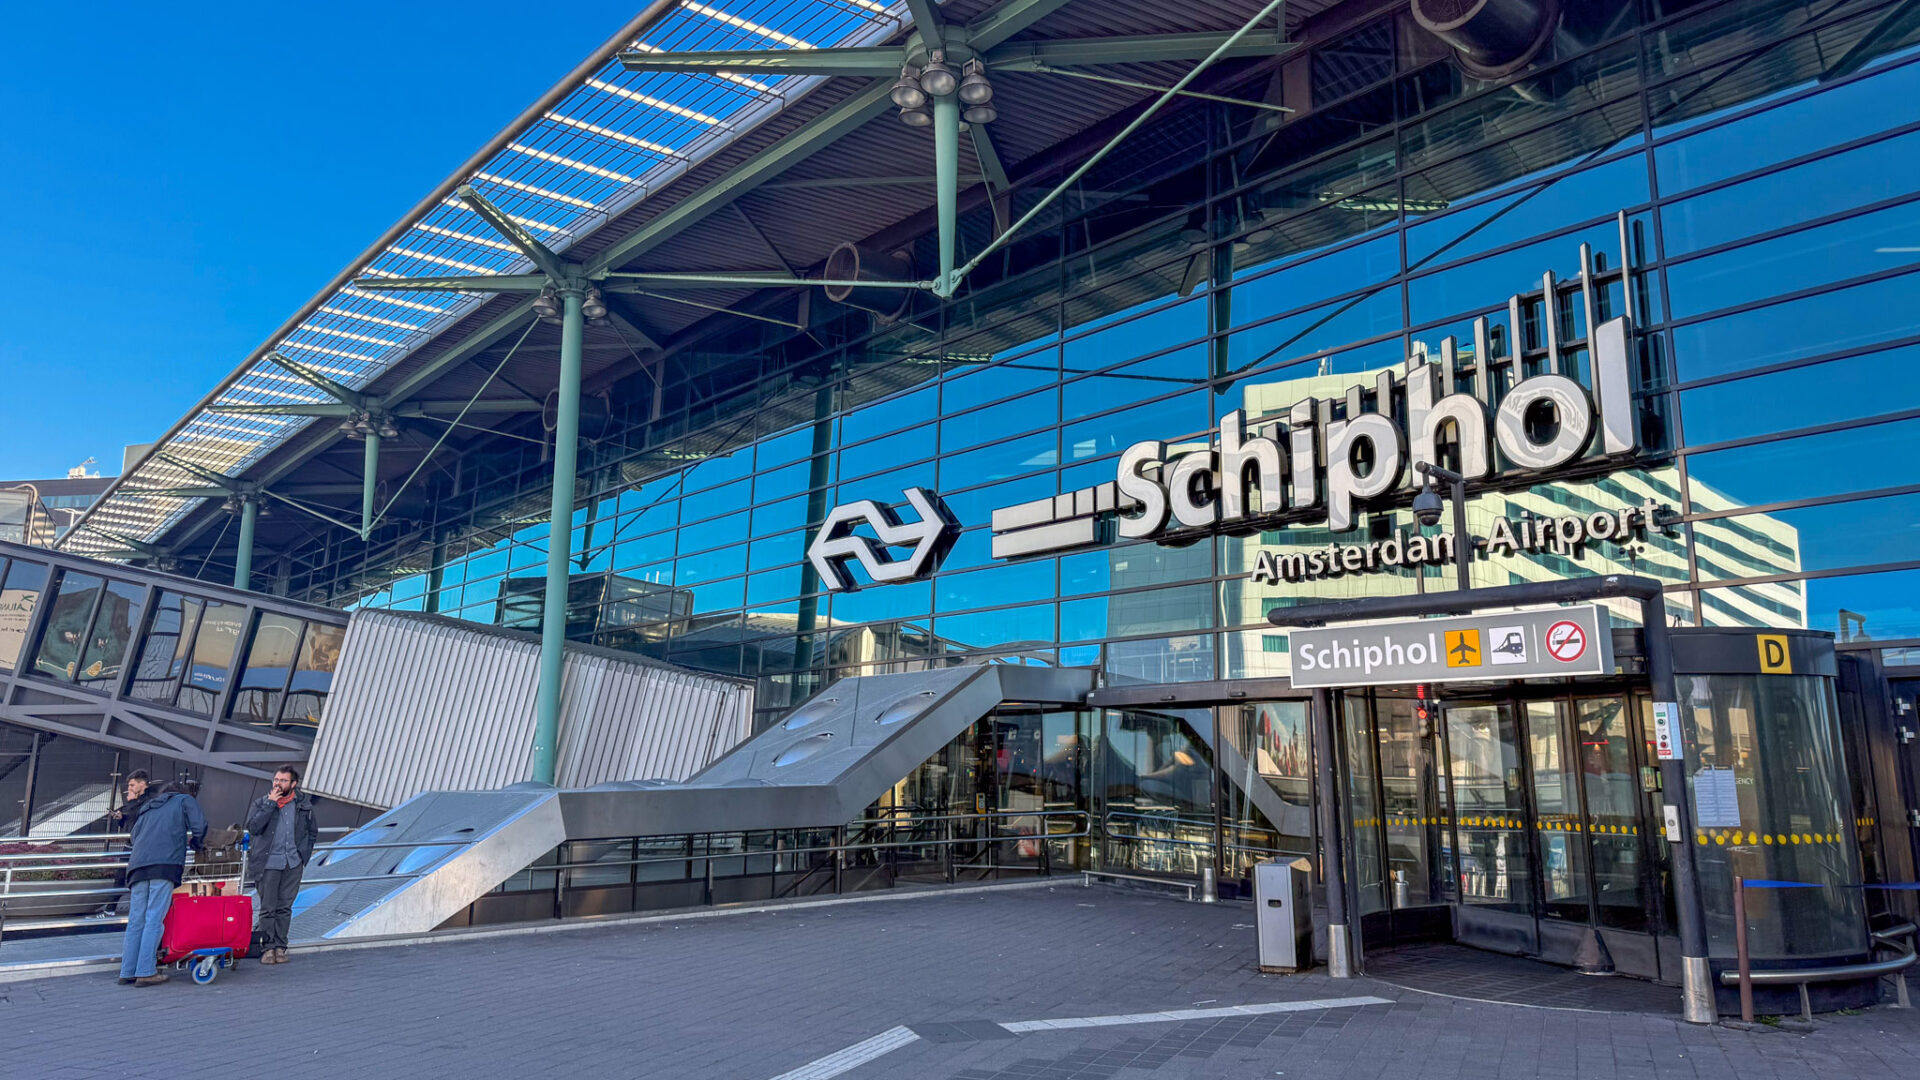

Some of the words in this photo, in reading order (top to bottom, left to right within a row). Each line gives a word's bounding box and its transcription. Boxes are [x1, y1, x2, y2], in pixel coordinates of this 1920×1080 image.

[1117, 315, 1637, 538] Schiphol
[1486, 497, 1662, 555] Airport
[1299, 632, 1438, 675] Schiphol
[1764, 639, 1785, 668] D
